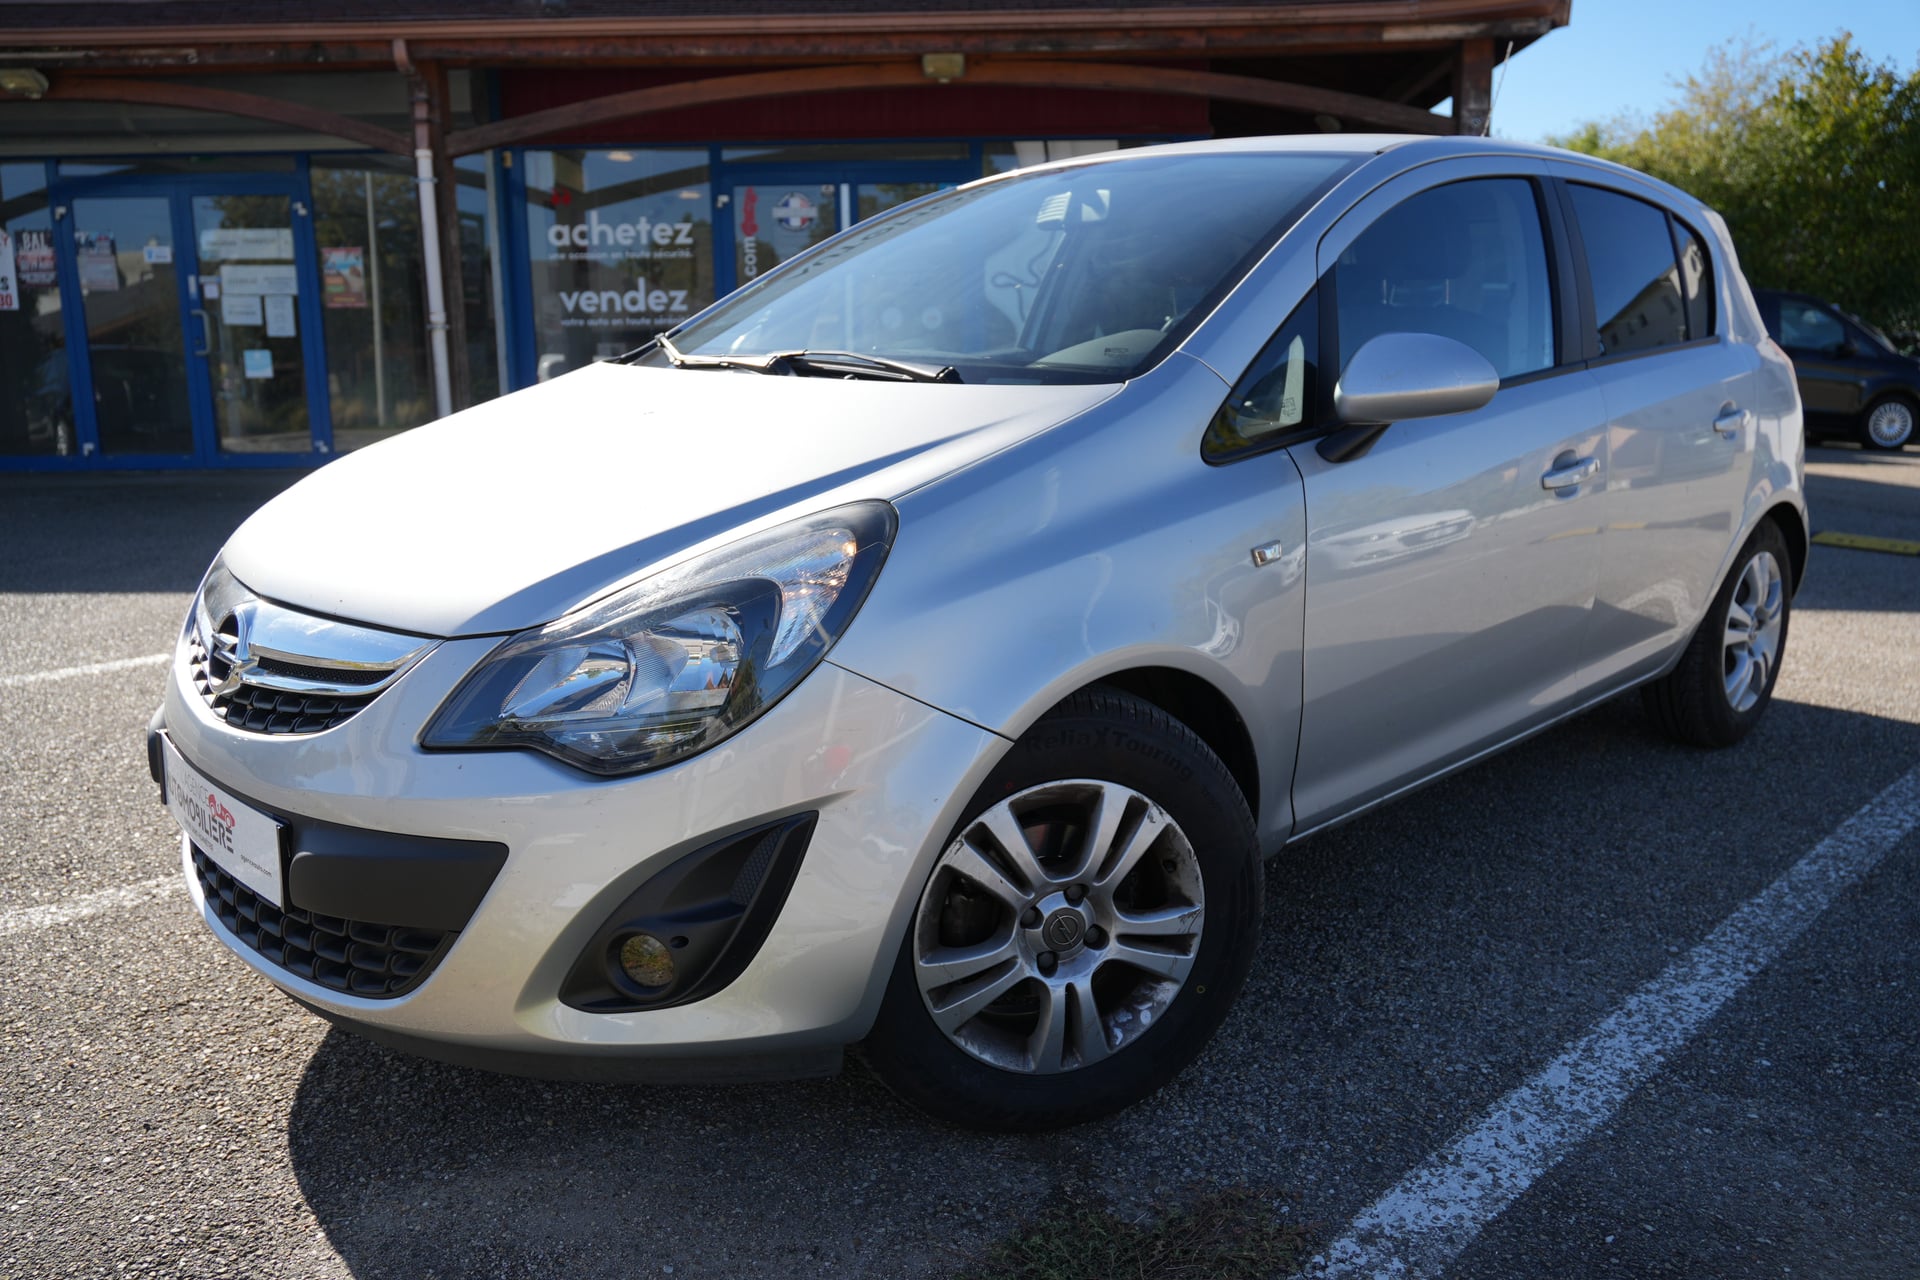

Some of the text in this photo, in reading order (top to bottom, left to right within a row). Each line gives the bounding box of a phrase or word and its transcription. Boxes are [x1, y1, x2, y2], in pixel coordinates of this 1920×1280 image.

[548, 211, 694, 246] achetez
[611, 250, 623, 258] en
[624, 247, 651, 258] toute
[560, 277, 688, 313] vendez
[586, 316, 609, 327] auto
[610, 317, 623, 327] en
[625, 315, 651, 327] toute
[167, 775, 235, 854] UTOMOBILIERE
